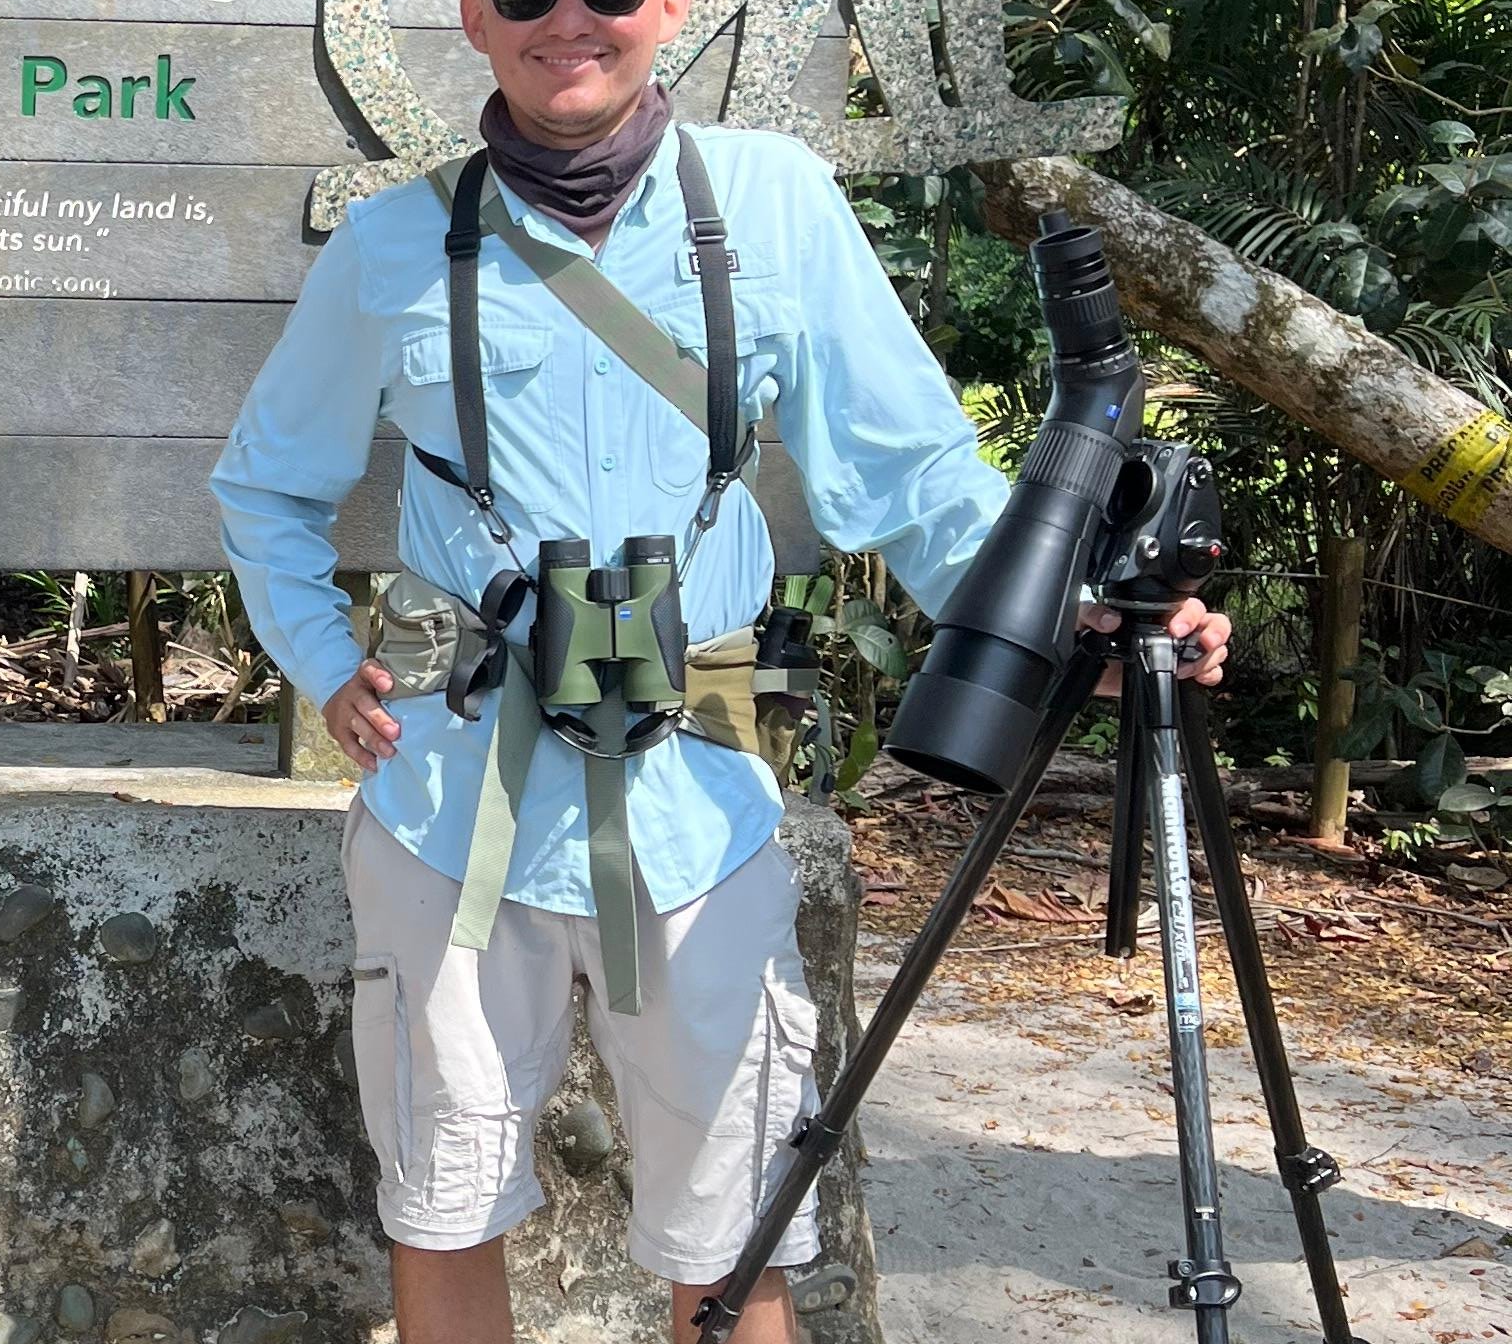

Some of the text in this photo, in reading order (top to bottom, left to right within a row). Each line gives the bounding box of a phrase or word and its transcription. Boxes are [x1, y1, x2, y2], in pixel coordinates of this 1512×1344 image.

[21, 53, 195, 121] Park
[58, 198, 103, 226] my
[112, 192, 178, 220] land
[185, 195, 215, 225] is,
[32, 227, 110, 253] sun."
